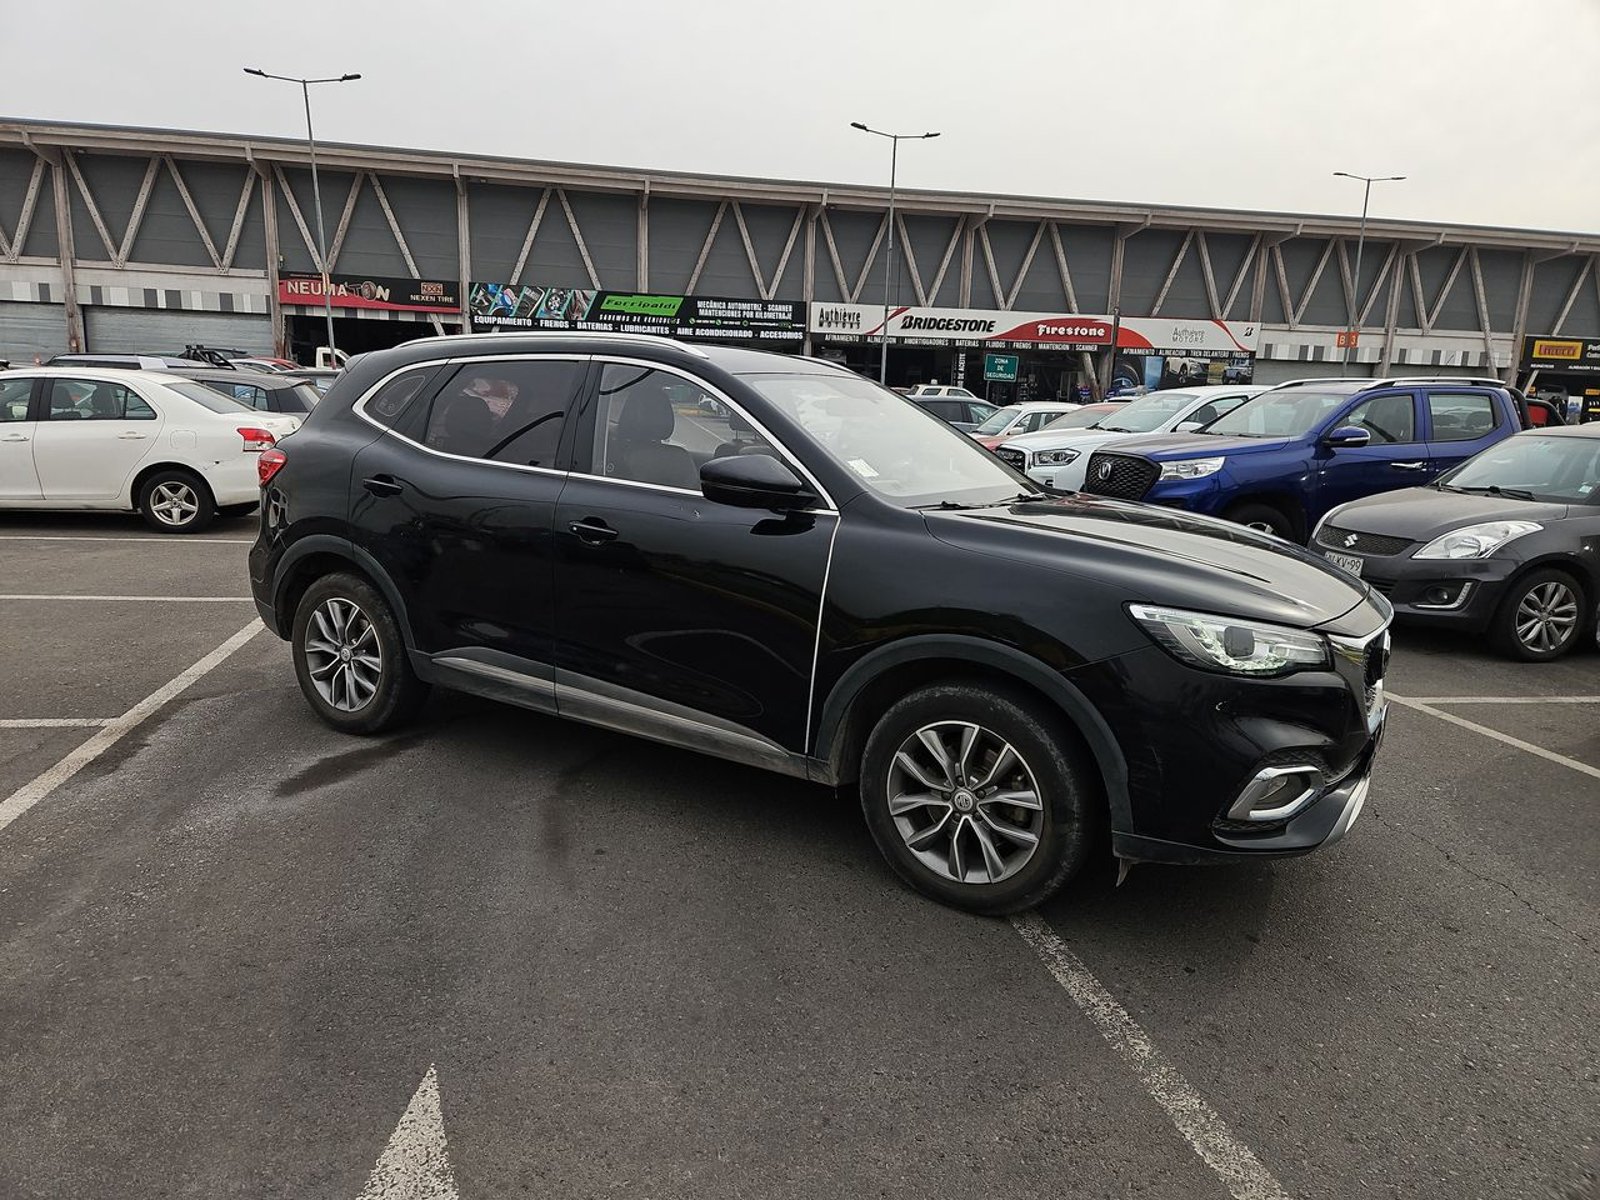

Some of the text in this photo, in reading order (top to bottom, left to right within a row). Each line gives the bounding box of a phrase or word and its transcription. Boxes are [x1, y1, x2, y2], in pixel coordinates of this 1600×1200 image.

[410, 294, 454, 304] NEXEN TIRE
[605, 299, 677, 309] Ferripaldi
[727, 301, 762, 311] AUTOMOTRIZ
[767, 304, 793, 312] SCANNER
[742, 310, 754, 319] POR
[474, 315, 804, 340] EQUIPAMIENTO FRENOS BATERIAS LUBRICANTES AIRE ACONDICIONADO ACCESORIOS
[900, 315, 997, 333] BRIDGESTONE
[1036, 323, 1106, 337] Firestone
[824, 333, 860, 343] AFINAMIENTO
[985, 340, 1006, 349] FLUIDOS
[1012, 341, 1032, 350] FRENOS
[1075, 344, 1099, 352] SCANNER
[994, 357, 1009, 365] ZONA
[996, 364, 1005, 372] DE
